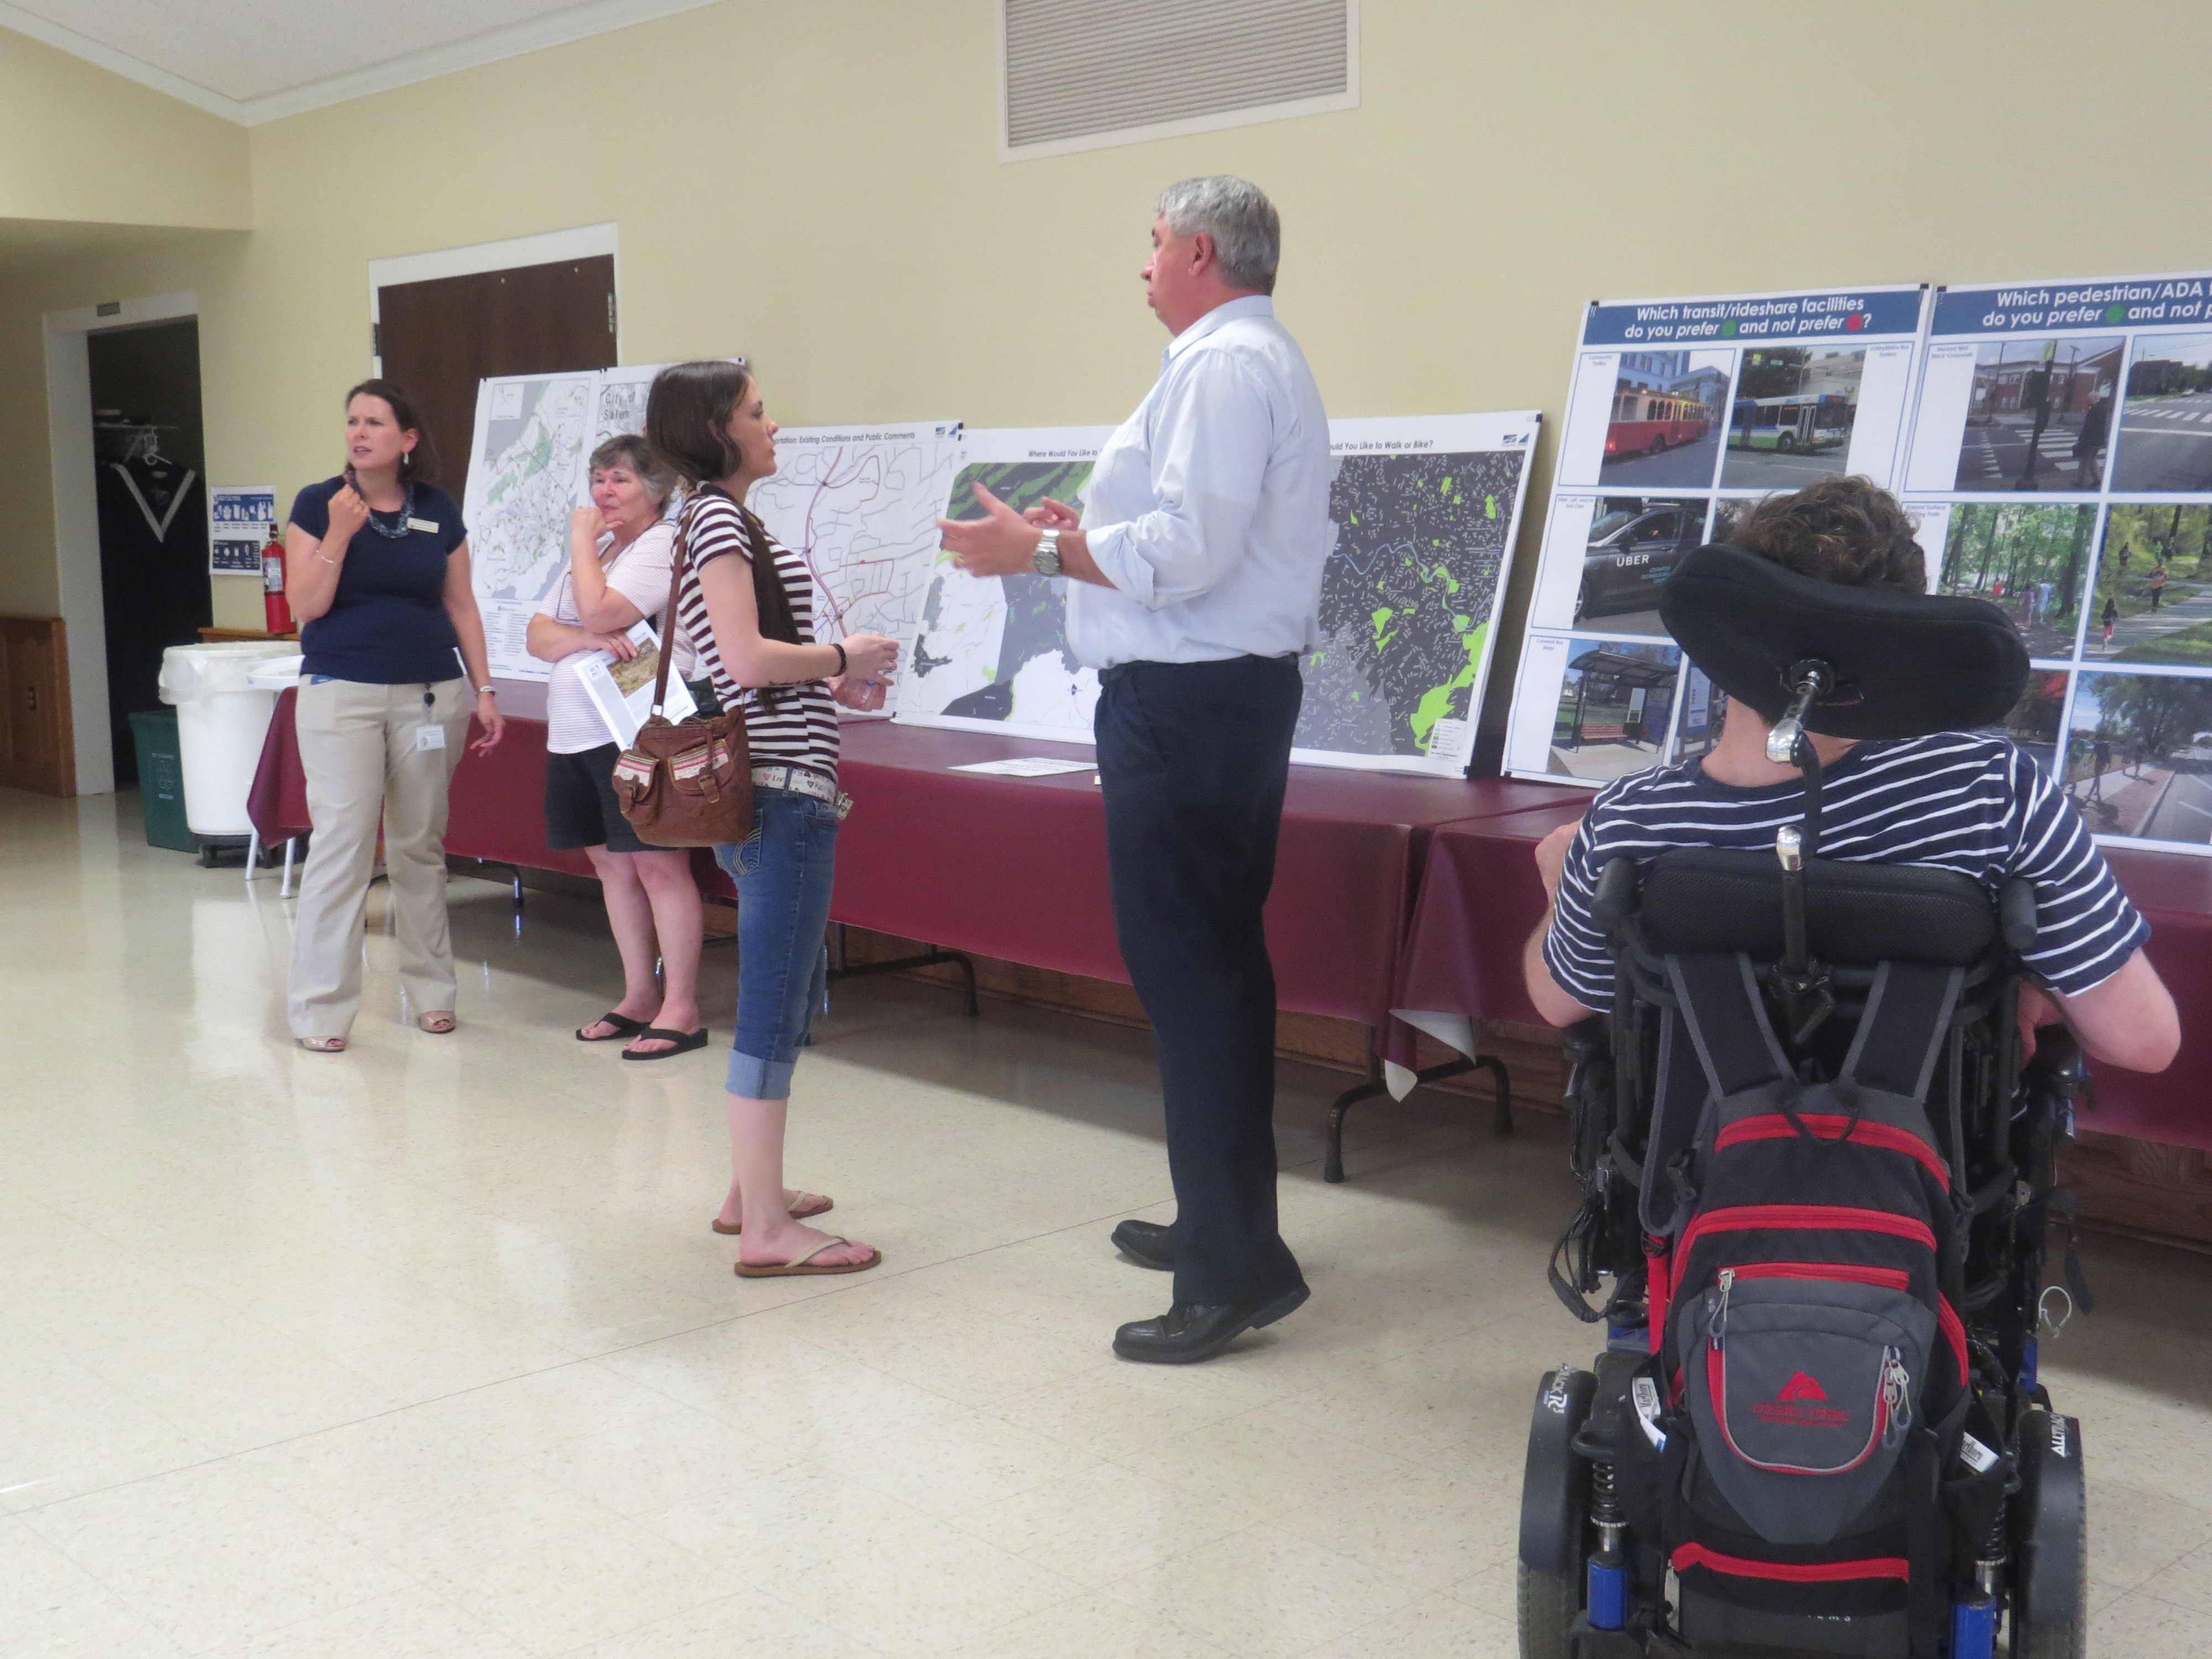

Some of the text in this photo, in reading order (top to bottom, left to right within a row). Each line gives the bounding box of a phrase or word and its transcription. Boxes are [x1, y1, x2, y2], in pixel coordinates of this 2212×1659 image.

[1997, 289, 2048, 307] Which
[2054, 281, 2203, 307] pedestrian/ADA
[1637, 296, 1864, 321] Which transit/rideshare facilities
[1982, 311, 2005, 327] do
[2010, 310, 2043, 328] you
[2047, 306, 2103, 326] prefer
[2128, 302, 2164, 320] and
[2169, 300, 2202, 318] not
[1625, 314, 1872, 340] do you prefer and not prefer ?
[852, 434, 864, 442] and
[865, 432, 883, 441] Public
[1413, 440, 1433, 448] Bike?
[1616, 554, 1649, 567] UBER
